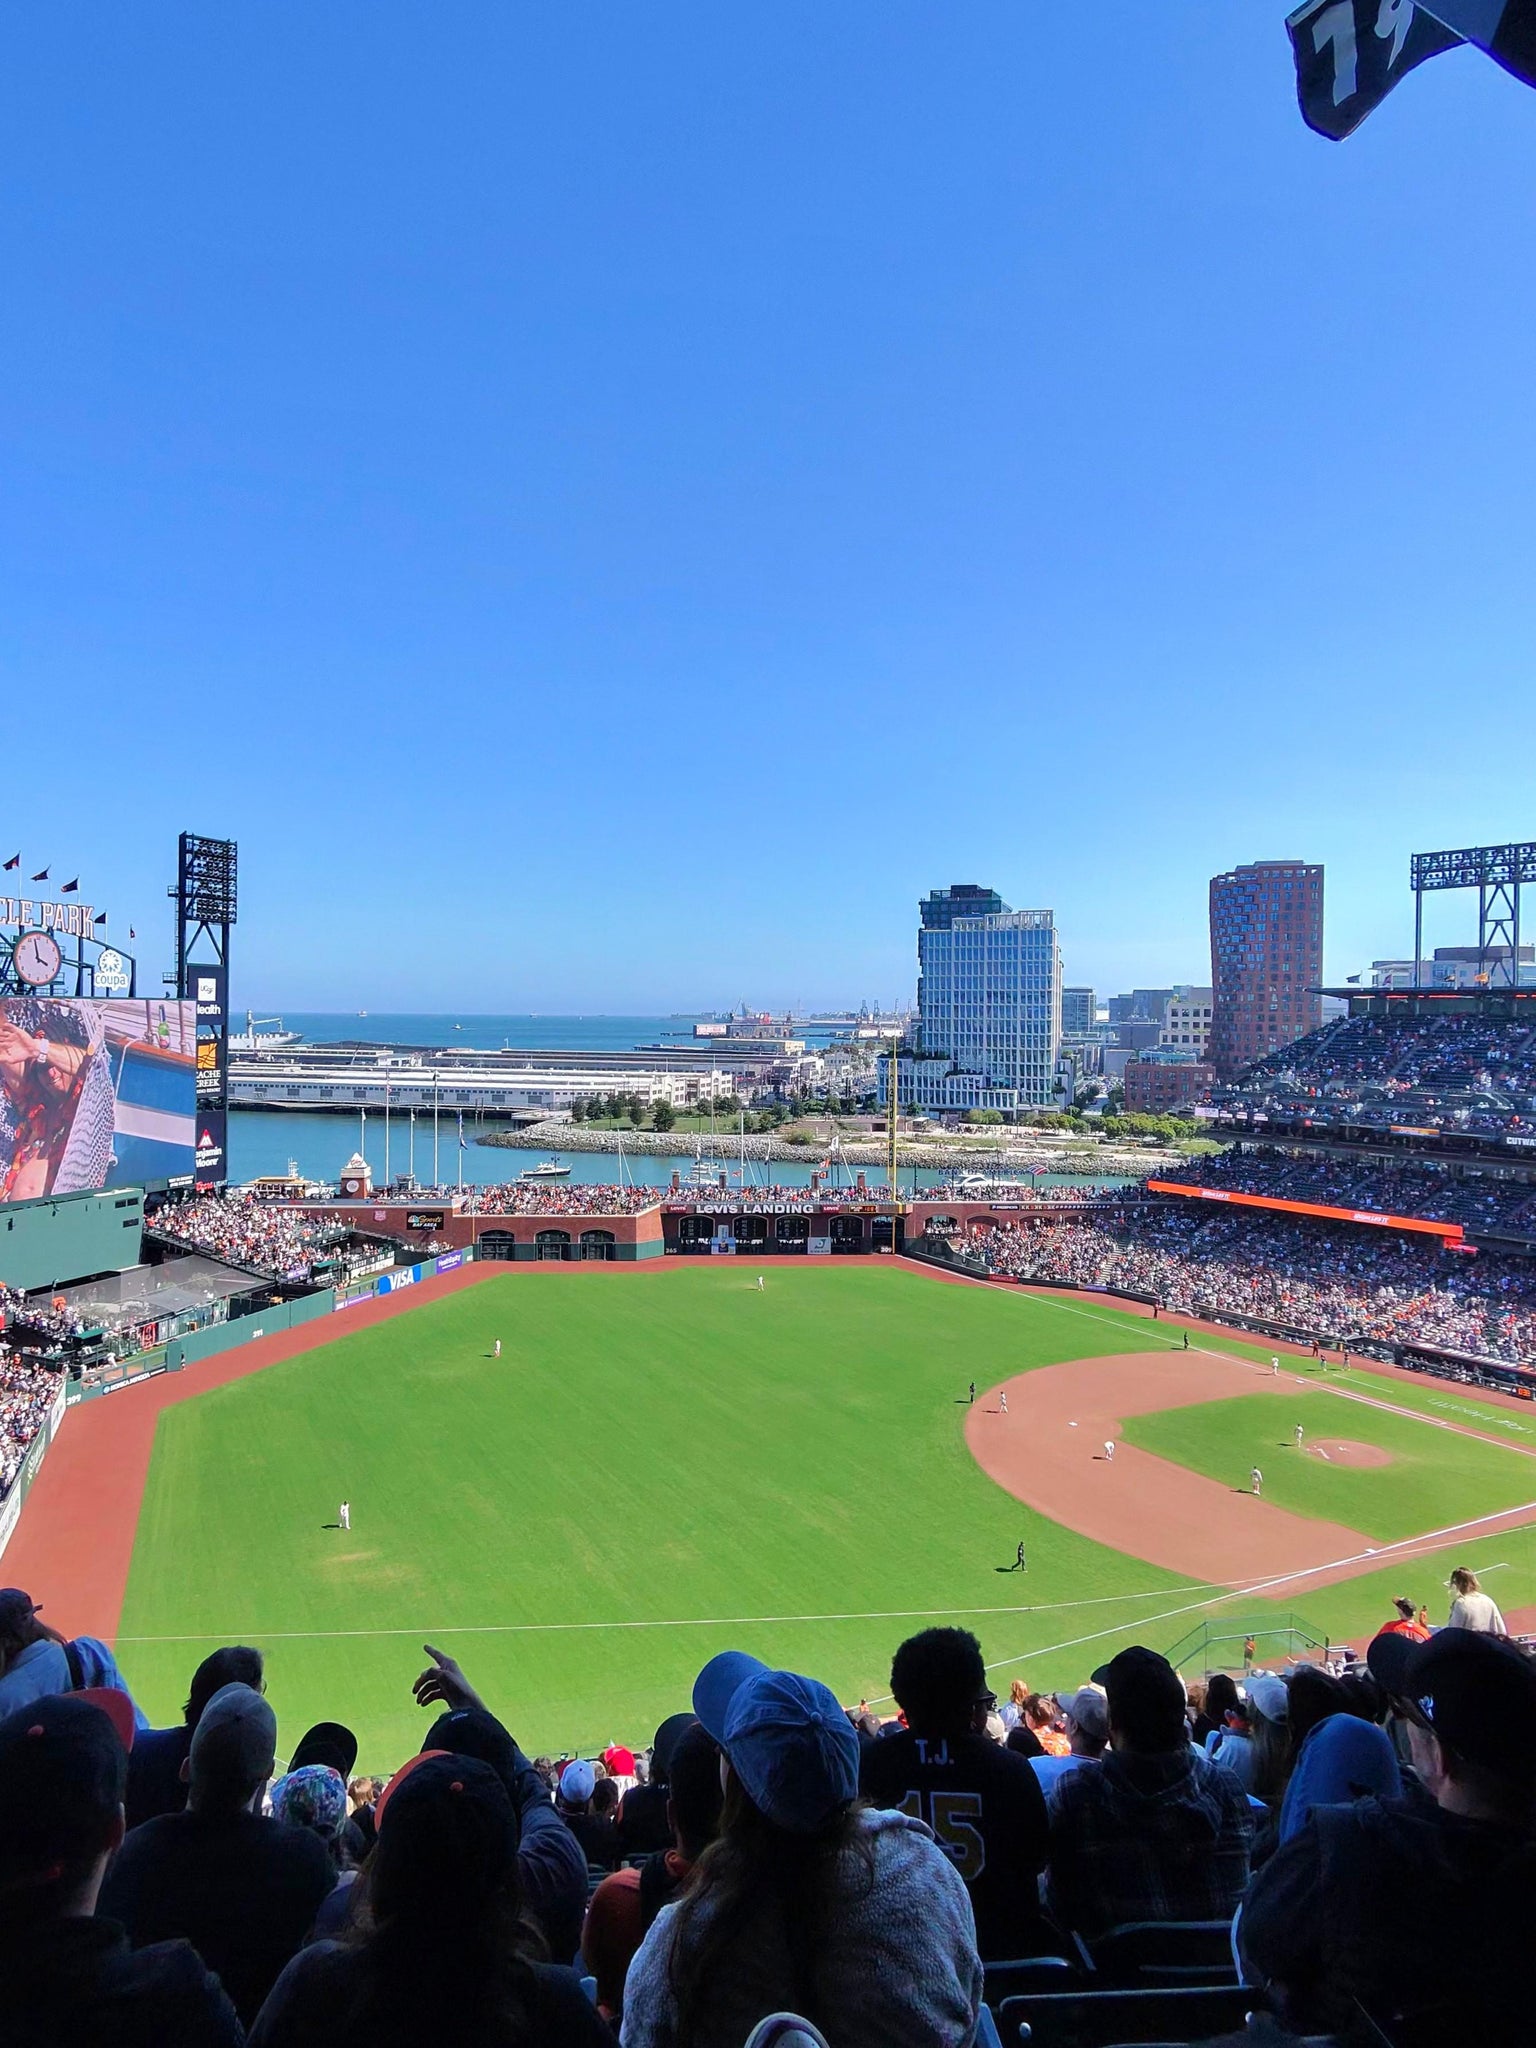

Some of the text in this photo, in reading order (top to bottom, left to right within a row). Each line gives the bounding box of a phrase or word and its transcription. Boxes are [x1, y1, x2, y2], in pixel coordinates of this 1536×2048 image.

[41, 902, 95, 941] PARK
[95, 974, 126, 987] coupa
[195, 1146, 222, 1160] enjamin
[743, 1204, 814, 1214] LANDING
[388, 1268, 415, 1291] VISA
[914, 1739, 955, 1765] T.J.
